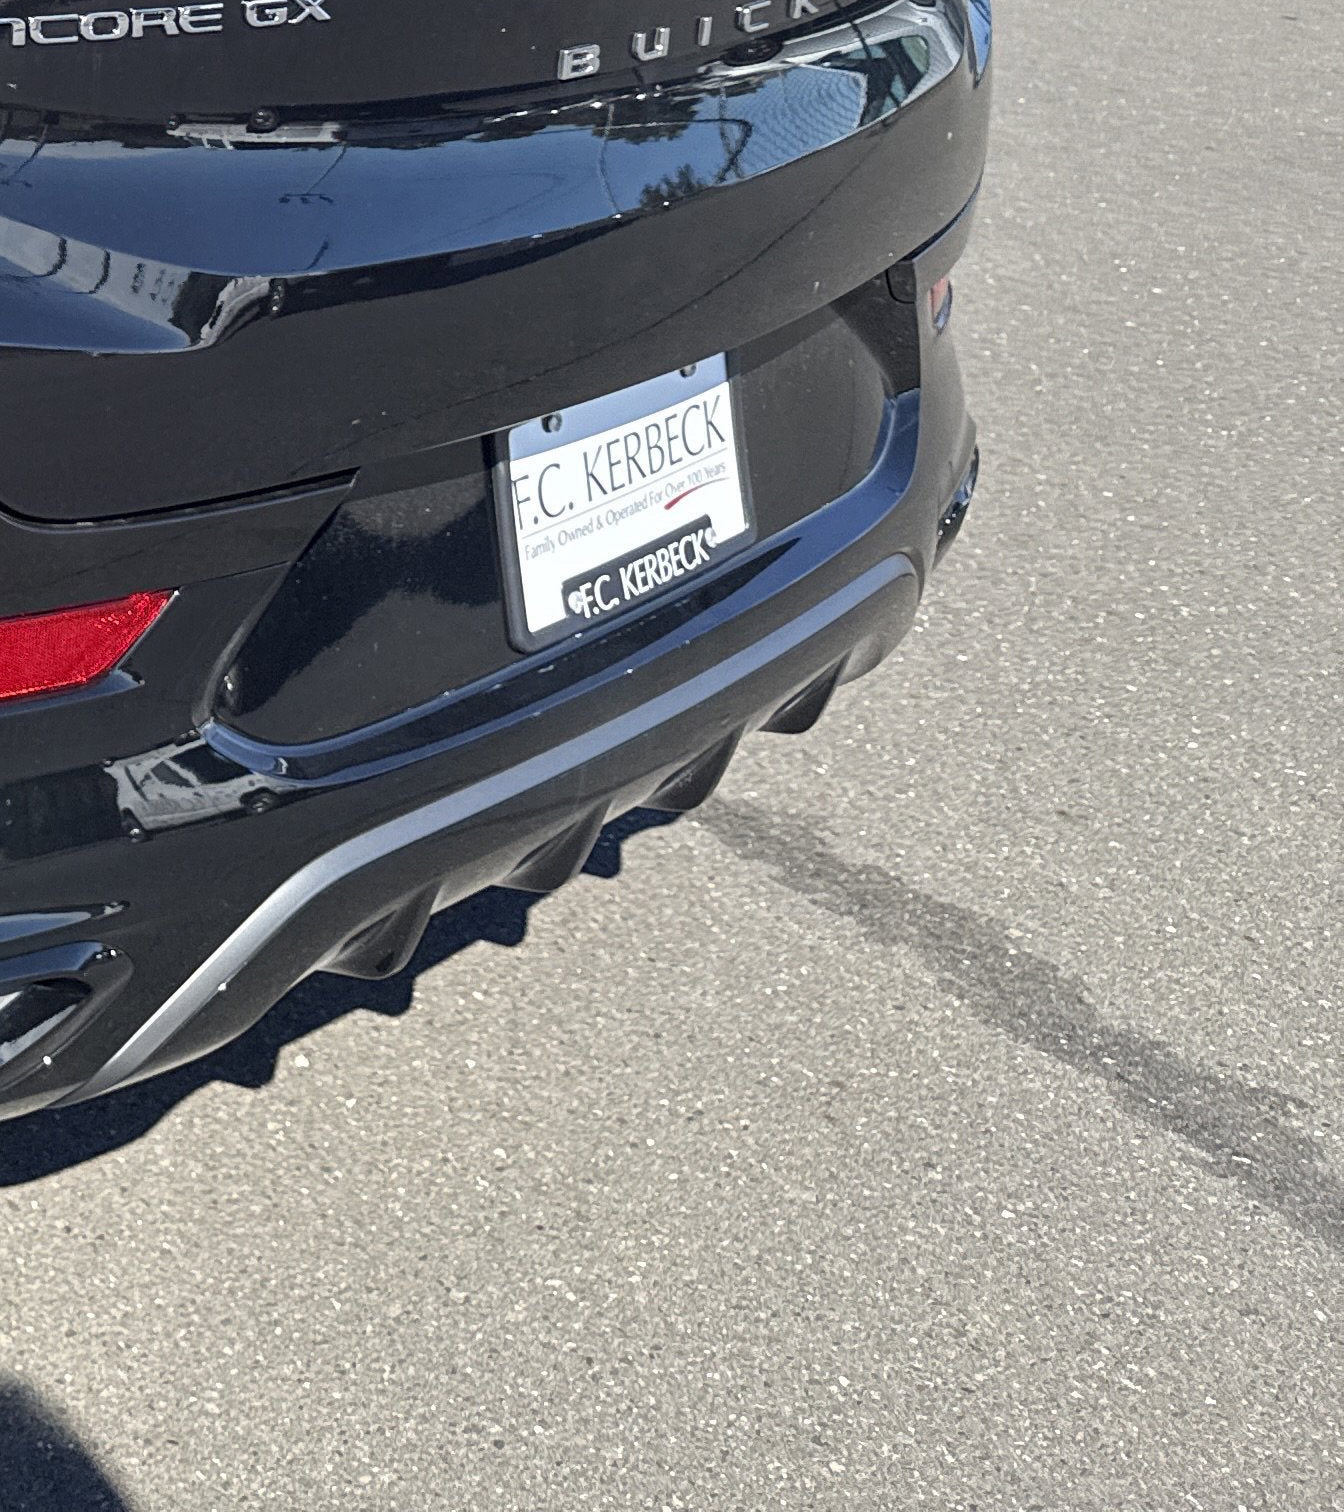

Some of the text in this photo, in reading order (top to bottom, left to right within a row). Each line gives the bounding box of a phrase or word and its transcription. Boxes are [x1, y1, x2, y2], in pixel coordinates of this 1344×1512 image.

[511, 395, 726, 530] F.C. KERBECK
[524, 535, 556, 561] Family
[557, 519, 595, 547] Owned
[596, 514, 605, 531] &
[605, 494, 649, 526] Operated
[649, 488, 664, 507] For
[664, 479, 686, 498] Over
[704, 461, 727, 481] Years
[579, 529, 710, 619] F.C. KERBECK
